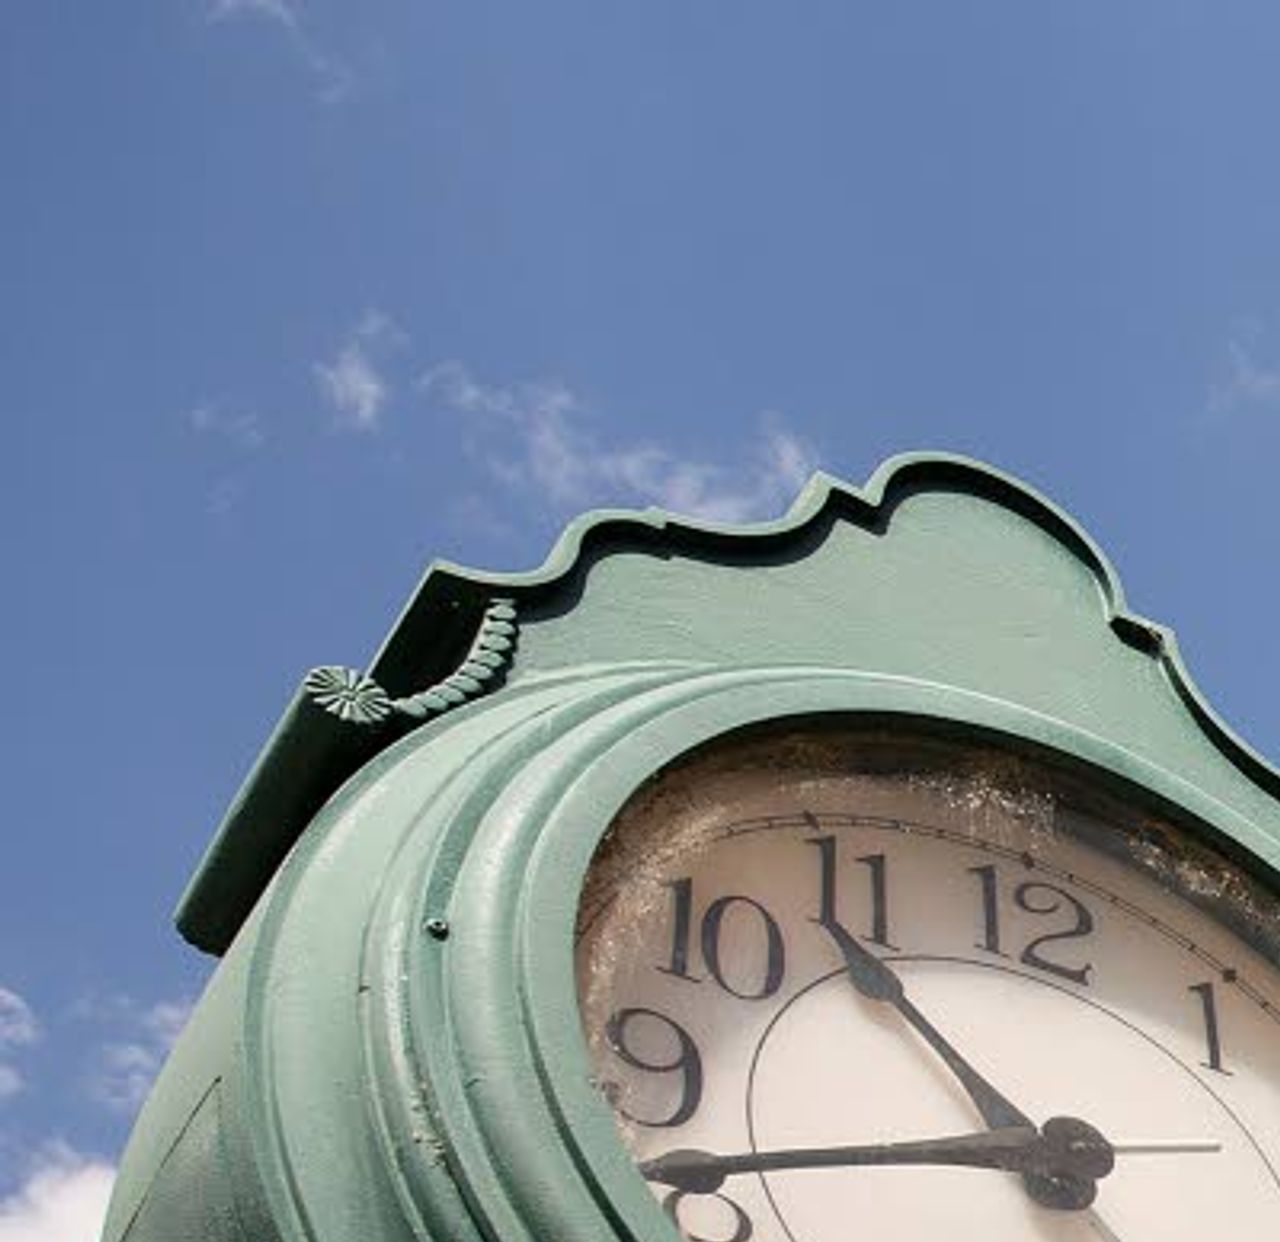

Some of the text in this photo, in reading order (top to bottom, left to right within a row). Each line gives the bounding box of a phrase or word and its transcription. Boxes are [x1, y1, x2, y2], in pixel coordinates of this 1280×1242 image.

[655, 877, 786, 1000] 10
[804, 834, 901, 952] 11
[967, 863, 1093, 986] 12
[607, 1007, 702, 1128] 9
[1188, 981, 1233, 1076] 1
